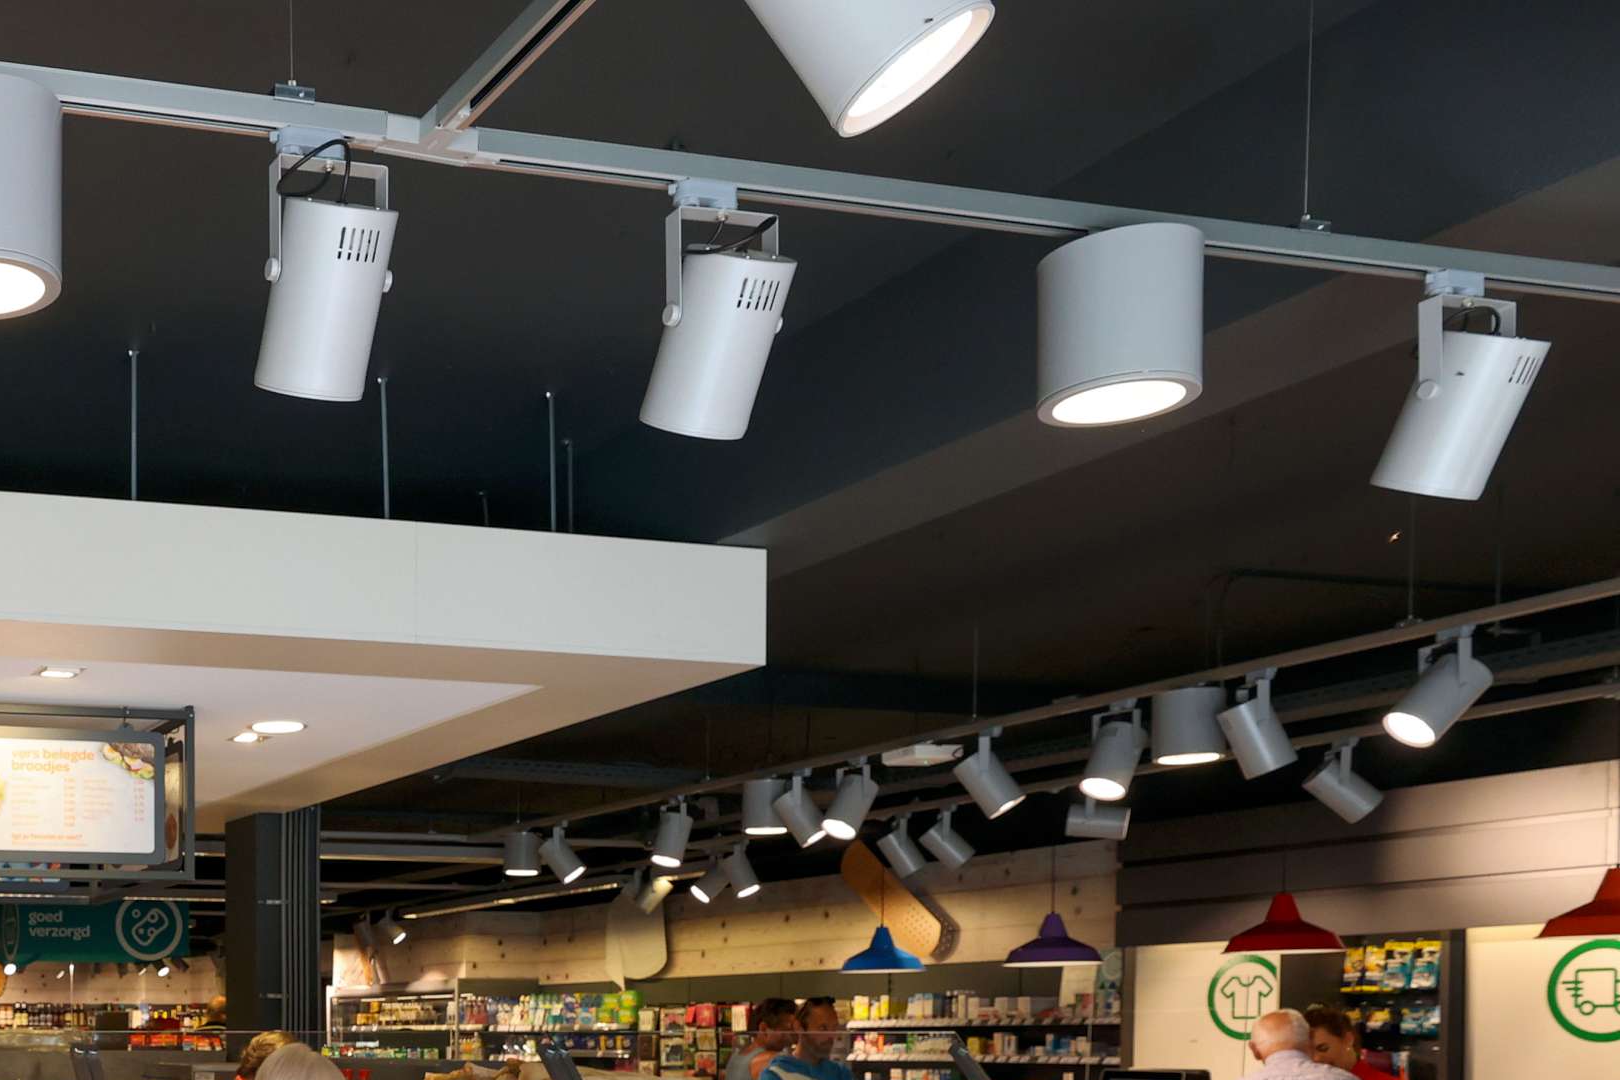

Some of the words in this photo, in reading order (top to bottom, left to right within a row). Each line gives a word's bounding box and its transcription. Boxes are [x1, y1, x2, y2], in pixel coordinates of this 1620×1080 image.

[11, 751, 40, 761] vers
[43, 748, 95, 762] belegde
[11, 759, 70, 774] broodjes
[28, 910, 64, 926] goed
[29, 924, 91, 941] verzorgd
